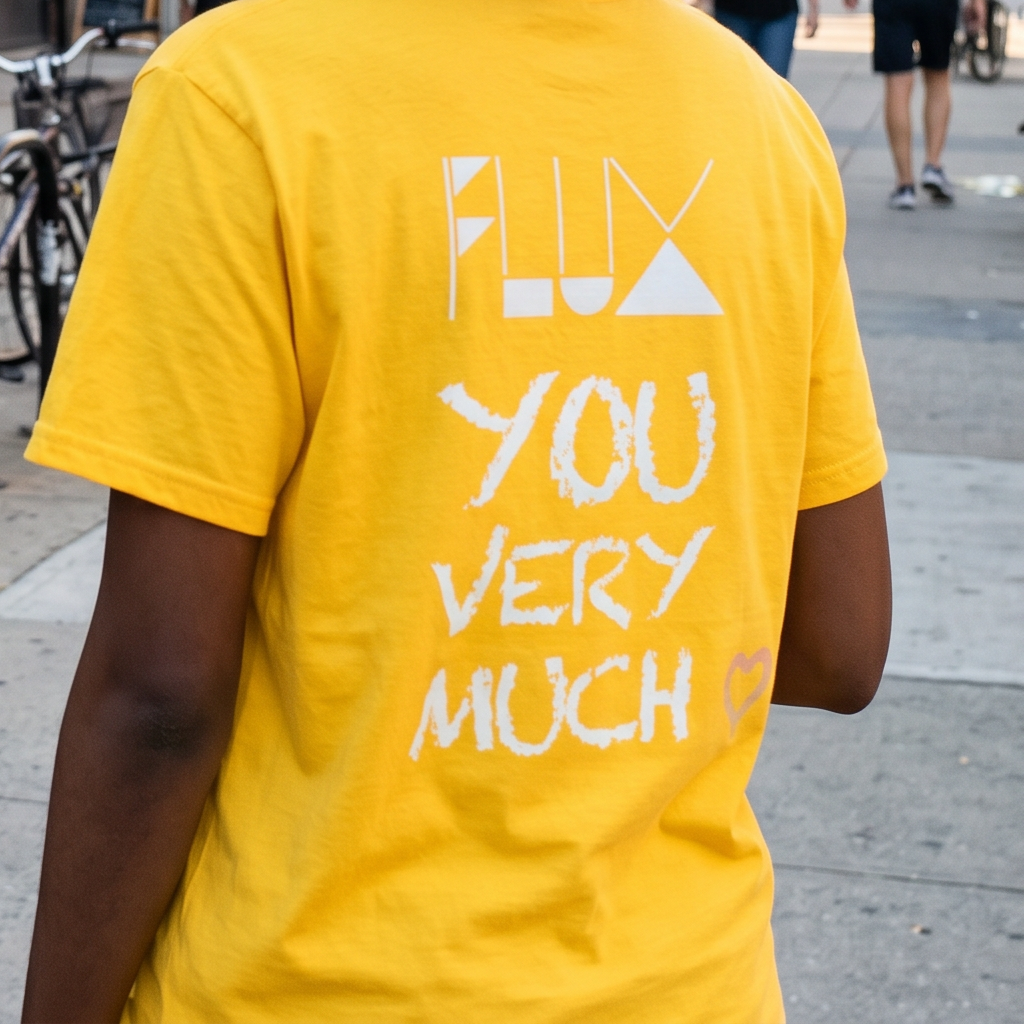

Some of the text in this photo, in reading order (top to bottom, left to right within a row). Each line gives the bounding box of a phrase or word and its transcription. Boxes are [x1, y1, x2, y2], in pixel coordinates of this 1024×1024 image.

[437, 371, 717, 509] YOU
[431, 525, 716, 637] VERY
[408, 648, 692, 761] MUCH
